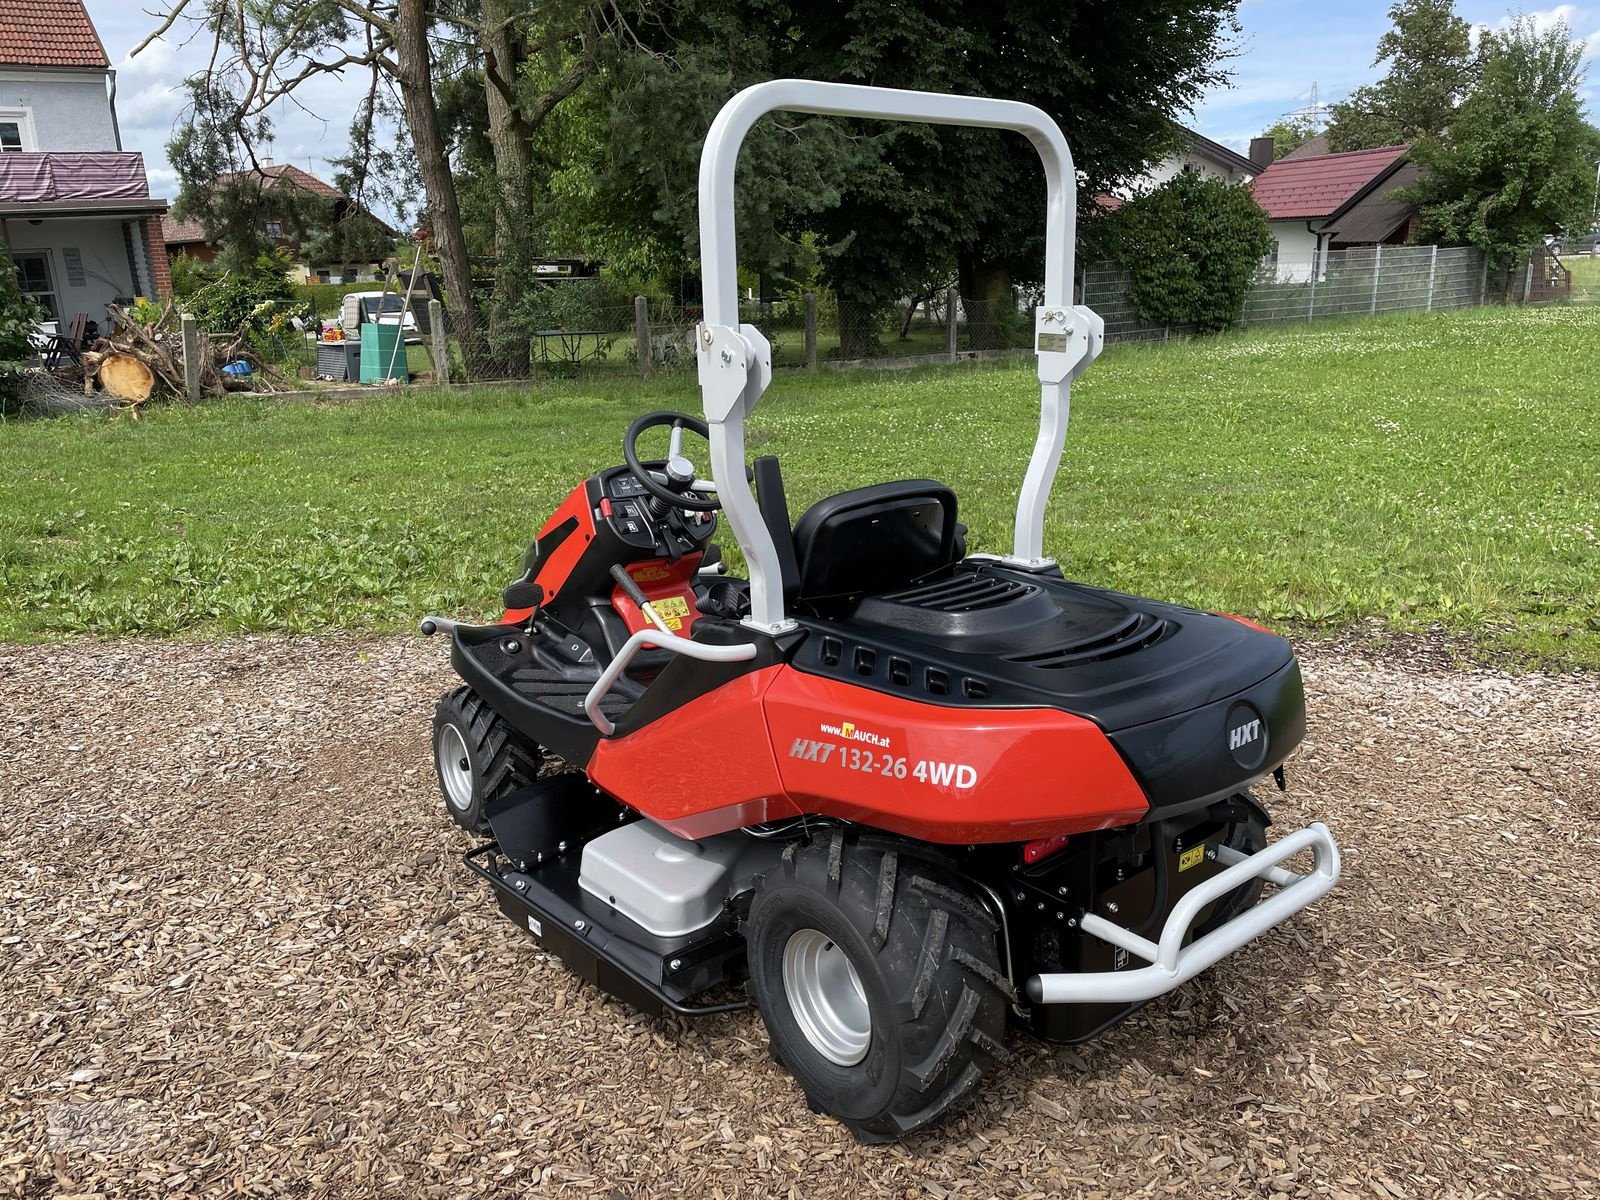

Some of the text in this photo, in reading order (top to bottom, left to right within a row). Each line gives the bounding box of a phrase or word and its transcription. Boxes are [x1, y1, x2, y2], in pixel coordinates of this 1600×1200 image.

[820, 722, 890, 748] www.MAUCH.at
[1229, 718, 1260, 751] HXT
[789, 738, 977, 789] HXT 132-26 4WD
